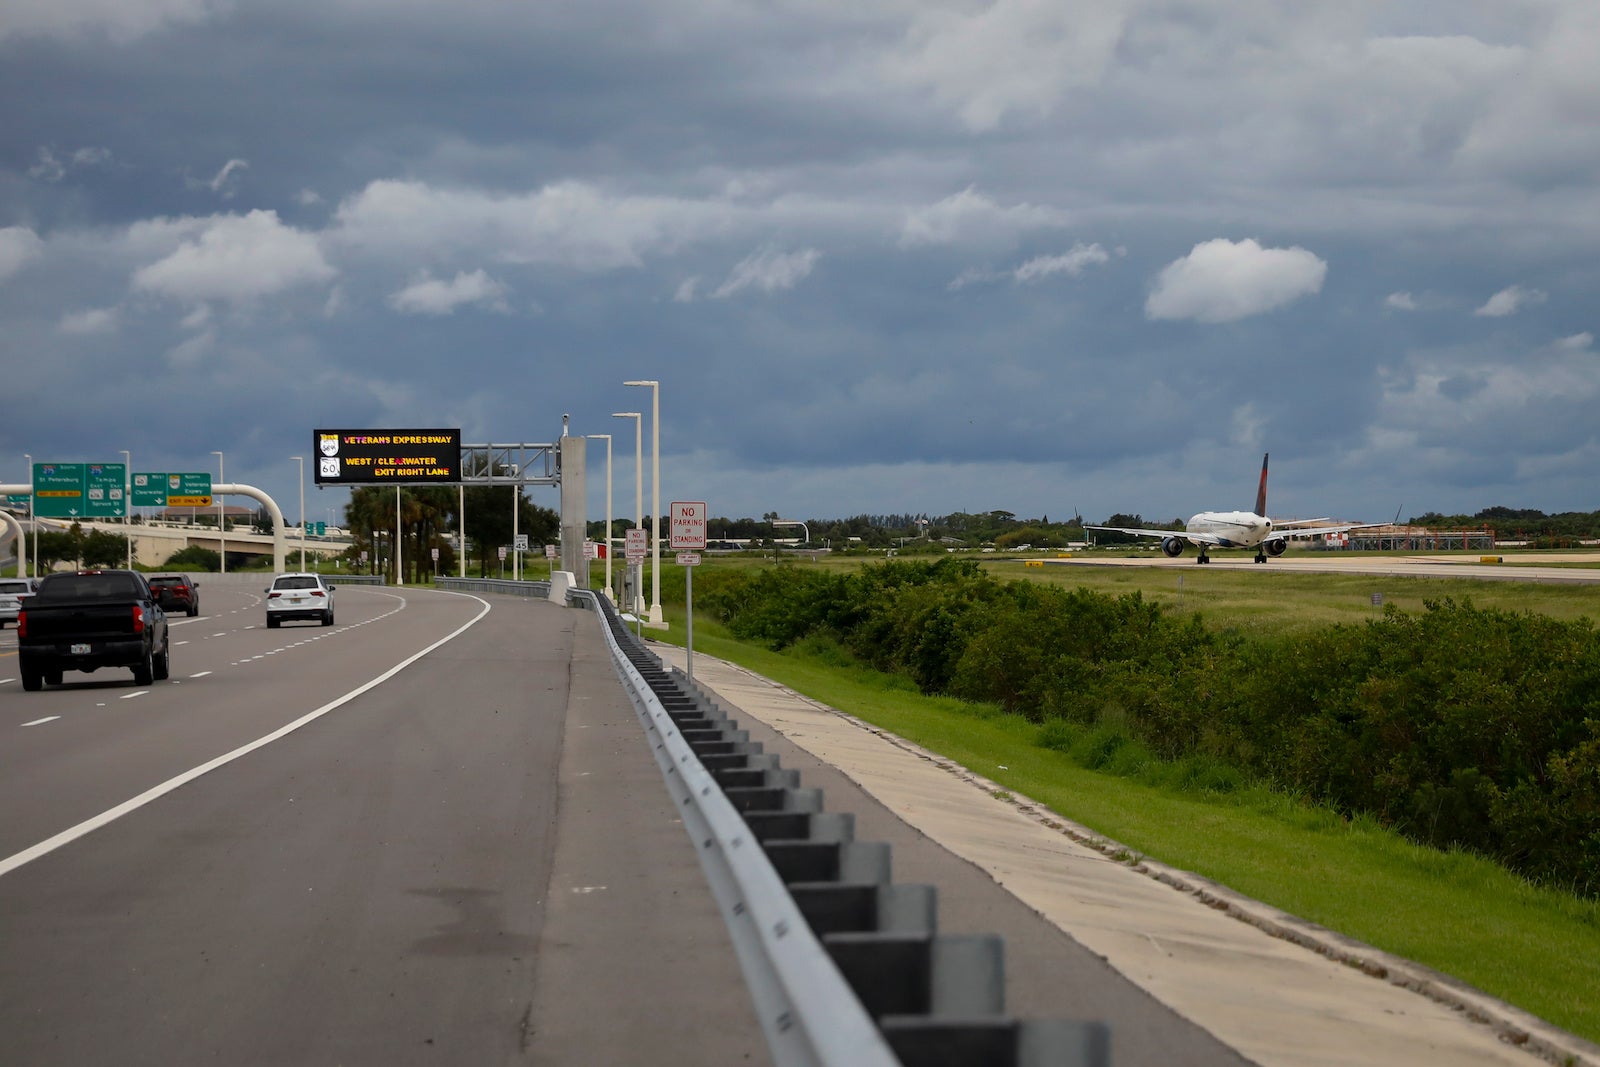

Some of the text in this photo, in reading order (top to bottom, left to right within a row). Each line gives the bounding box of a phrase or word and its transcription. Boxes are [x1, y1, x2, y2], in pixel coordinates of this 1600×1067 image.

[344, 436, 451, 444] VETERANS EXPRESSWAY
[345, 457, 372, 465] WEST
[378, 457, 437, 465] CLEARWATER
[323, 464, 336, 473] 60
[375, 468, 395, 476] EXIT
[397, 468, 424, 476] RIGHT
[682, 507, 695, 517] NO
[674, 519, 703, 527] PARKING
